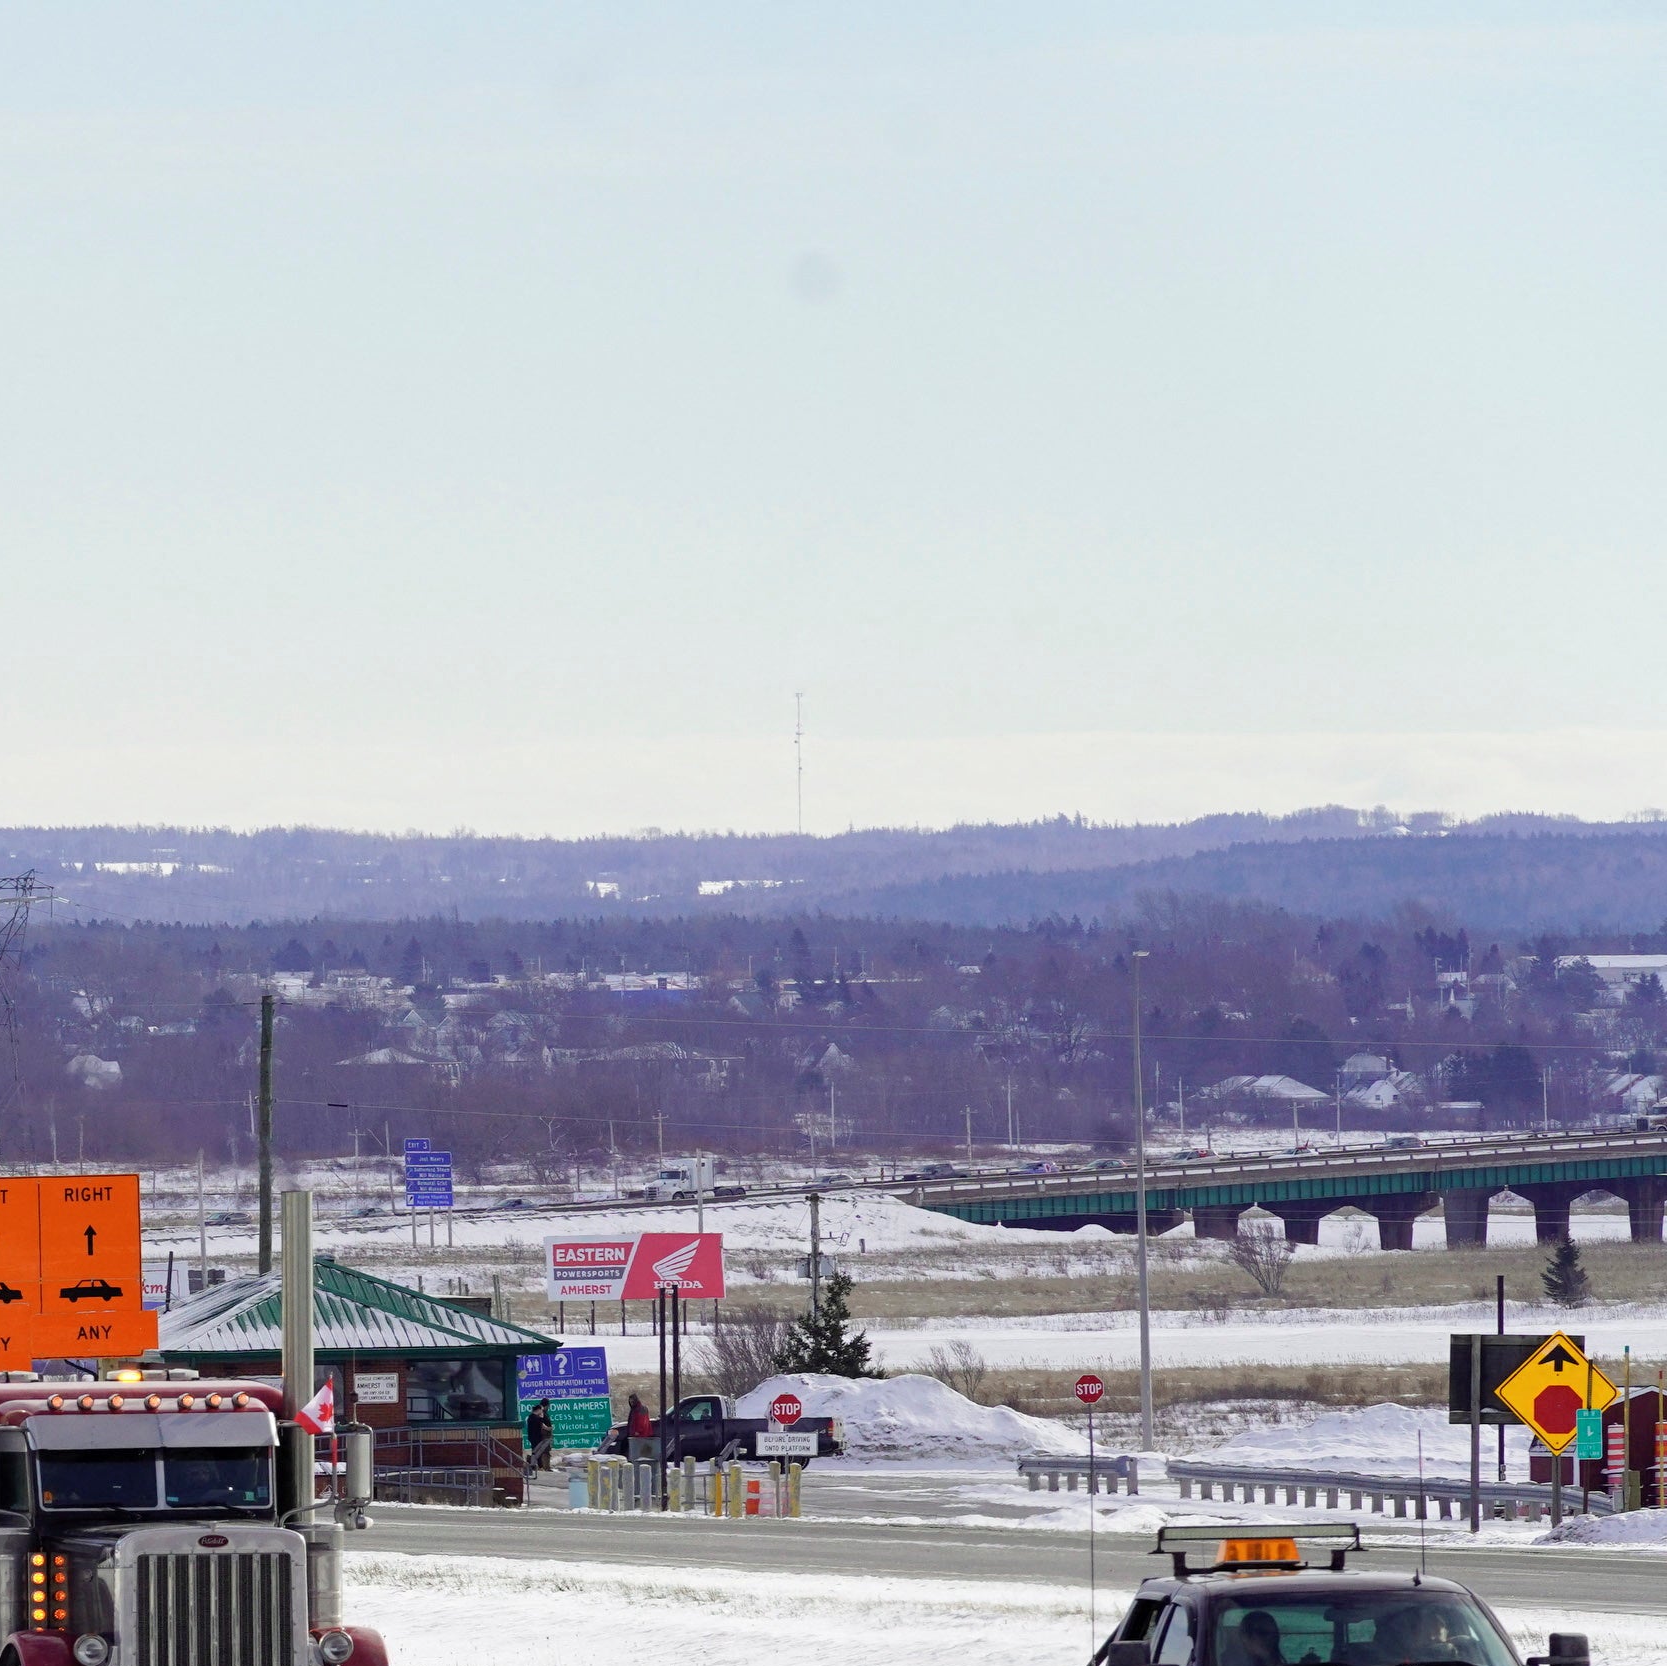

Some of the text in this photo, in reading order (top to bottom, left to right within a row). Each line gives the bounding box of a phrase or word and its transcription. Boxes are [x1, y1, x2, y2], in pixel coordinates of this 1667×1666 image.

[423, 1141, 427, 1149] 3
[64, 1187, 112, 1202] RIGHT
[556, 1248, 625, 1262] EASTERN
[556, 1270, 621, 1278] POWERSPORTS
[560, 1285, 612, 1295] AMHERST
[653, 1280, 703, 1289] HONDA
[77, 1325, 112, 1340] ANY
[535, 1388, 556, 1396] ACCESS
[1077, 1383, 1102, 1395] STOP
[520, 1401, 608, 1412] DOOWN AMHERST
[774, 1403, 801, 1415] STOP
